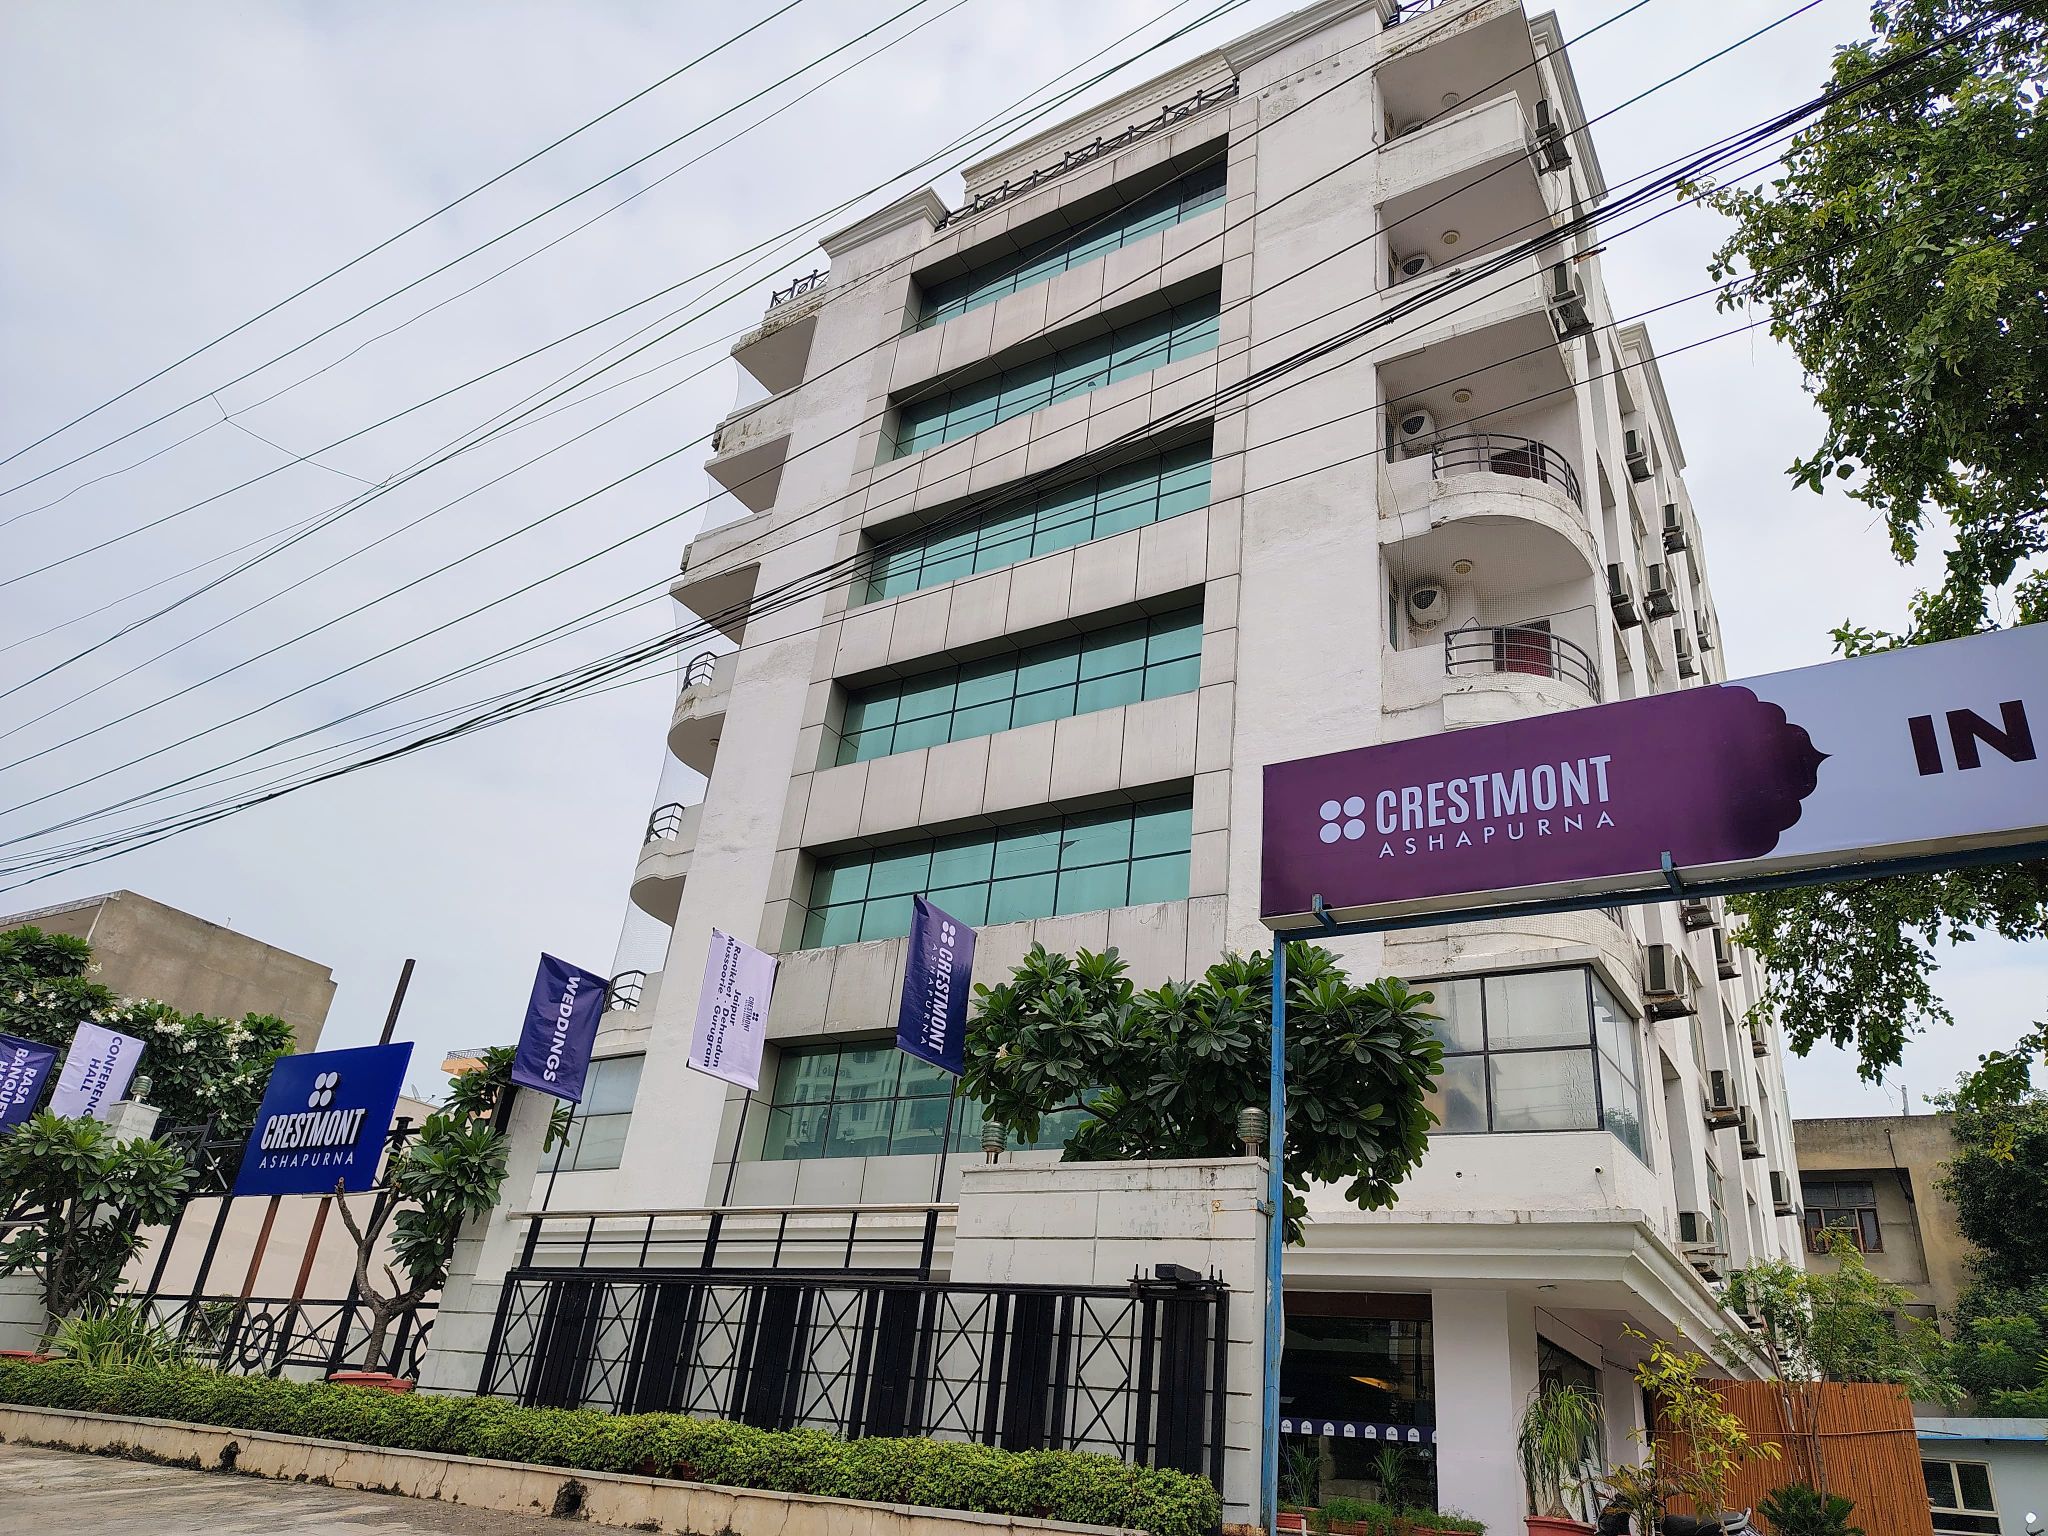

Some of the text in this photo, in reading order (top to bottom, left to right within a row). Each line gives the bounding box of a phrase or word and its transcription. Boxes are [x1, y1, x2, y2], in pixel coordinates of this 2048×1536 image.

[1908, 699, 2037, 776] IN
[1375, 754, 1611, 834] CRESTMONT
[1378, 810, 1615, 858] ASHAPURNA
[543, 976, 581, 1083] WEDDINGS
[703, 935, 735, 1068] Mussoorie Gurugram
[713, 945, 741, 1067] Ranikhet Dehradun
[729, 989, 741, 1026] Jaipur
[920, 943, 937, 1045] ASHAPURNA
[928, 947, 953, 1054] CRESTMONT
[12, 1067, 38, 1105] RASA
[80, 1058, 101, 1092] HALL
[83, 1036, 123, 1116] CONFERENC
[259, 1152, 354, 1169] ASHAPURNA
[261, 1108, 365, 1150] CRESTMONT
